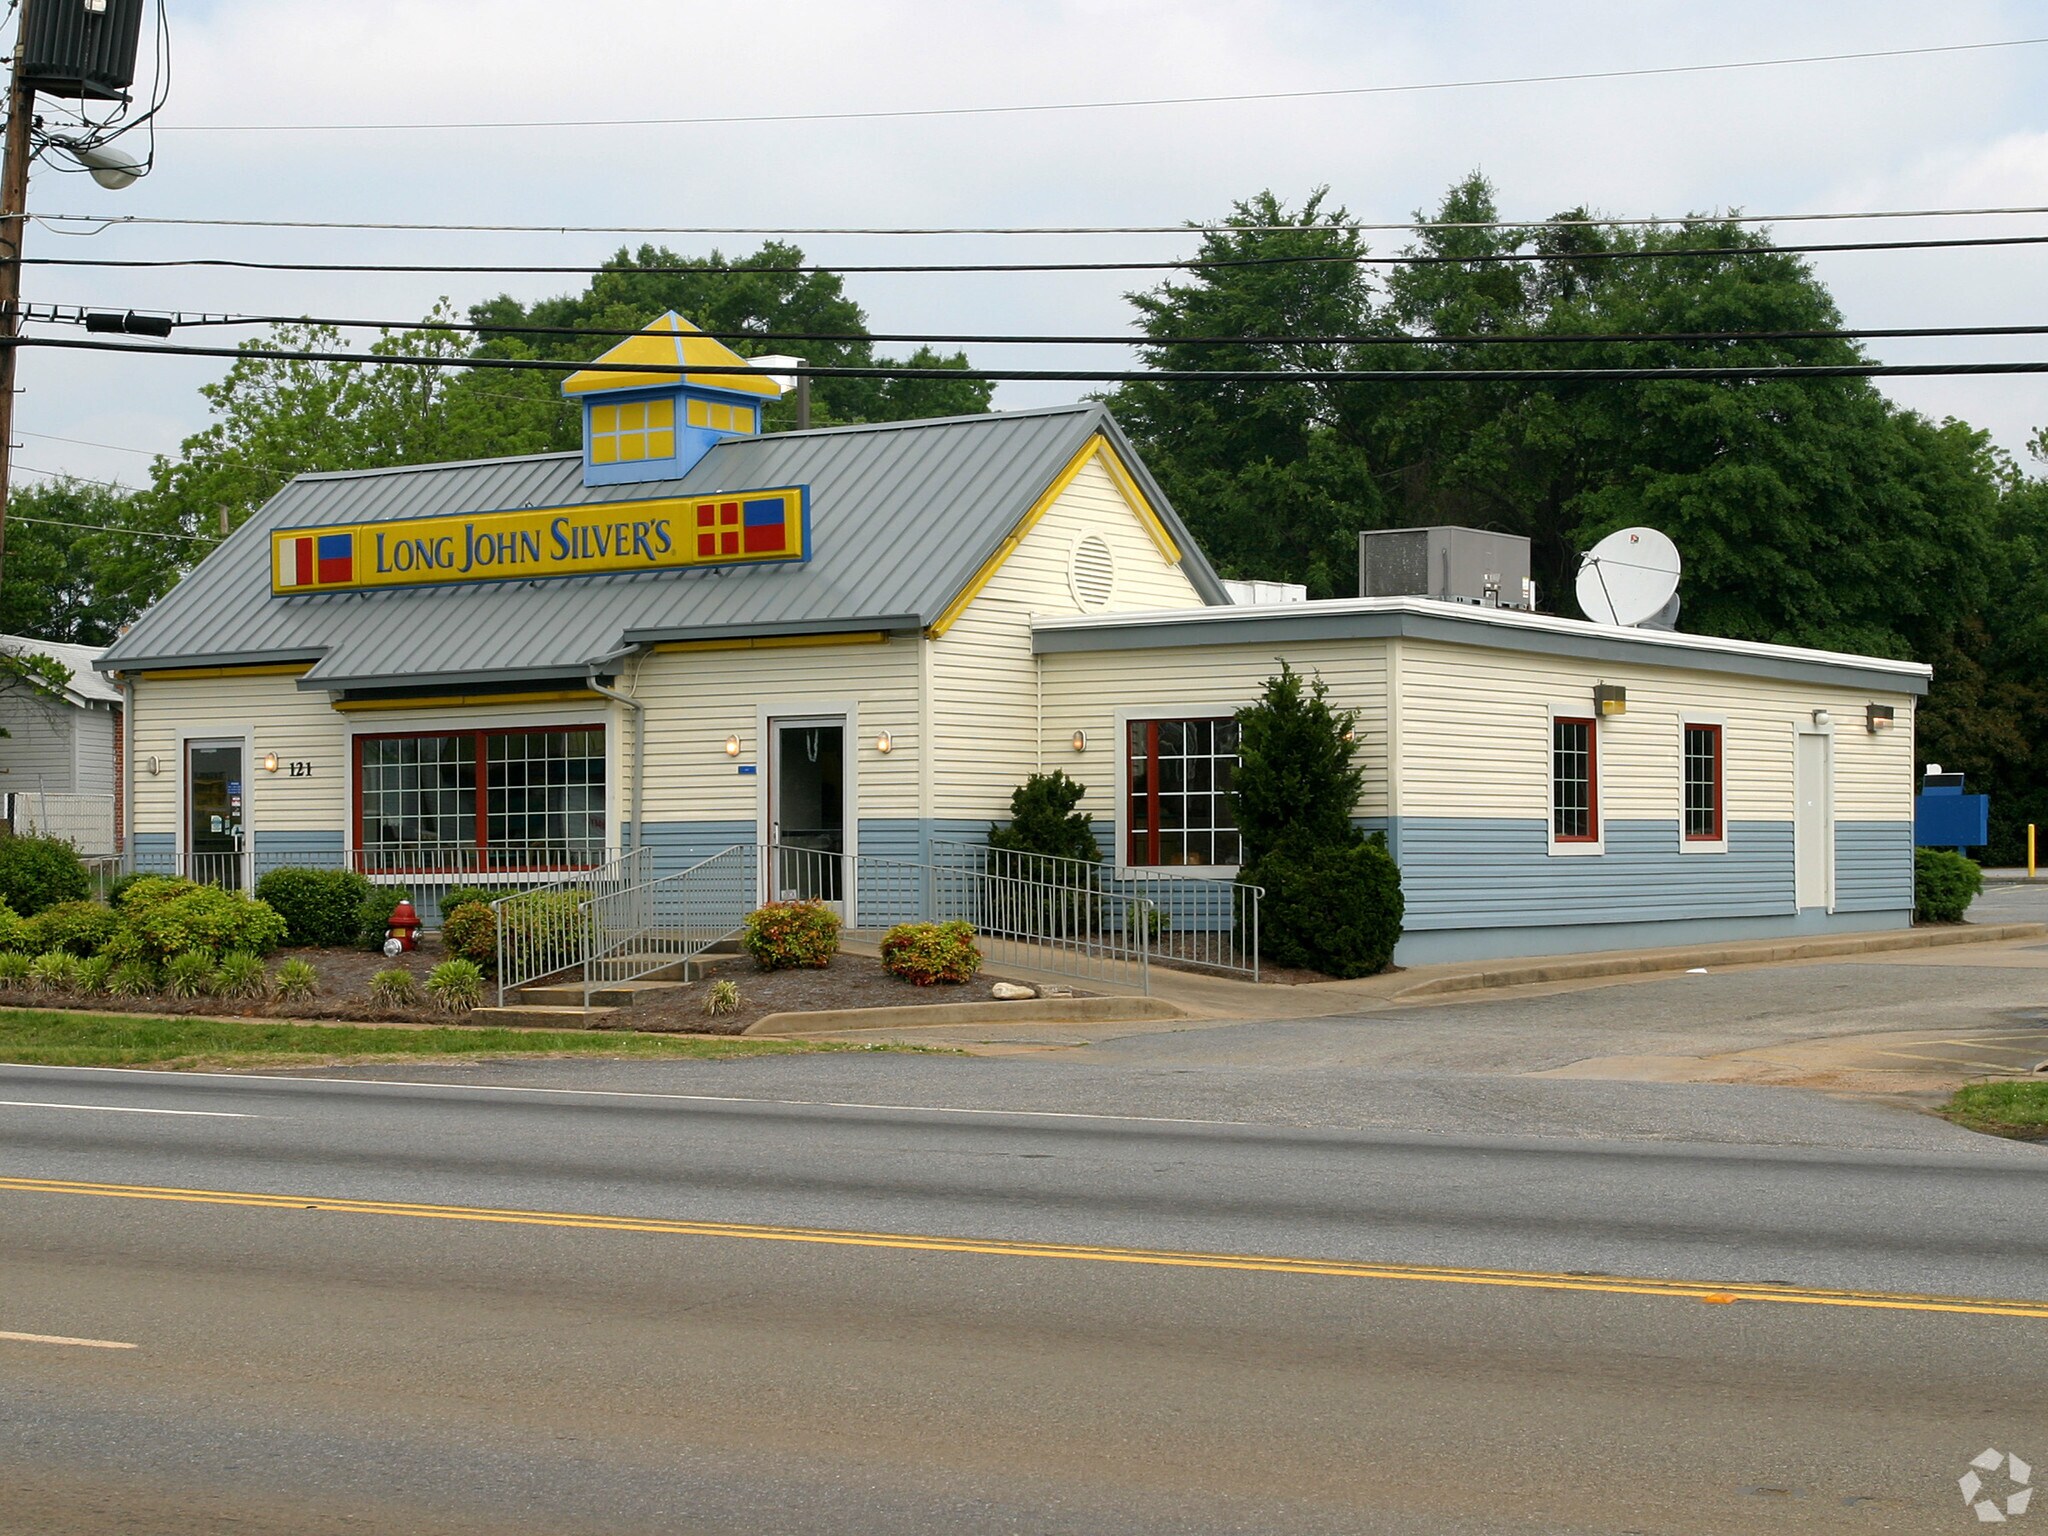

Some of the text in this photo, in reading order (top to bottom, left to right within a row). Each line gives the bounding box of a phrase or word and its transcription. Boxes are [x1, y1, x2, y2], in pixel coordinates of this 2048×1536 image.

[376, 517, 671, 573] LONG JOHN SILVER'S
[289, 761, 312, 777] 121
